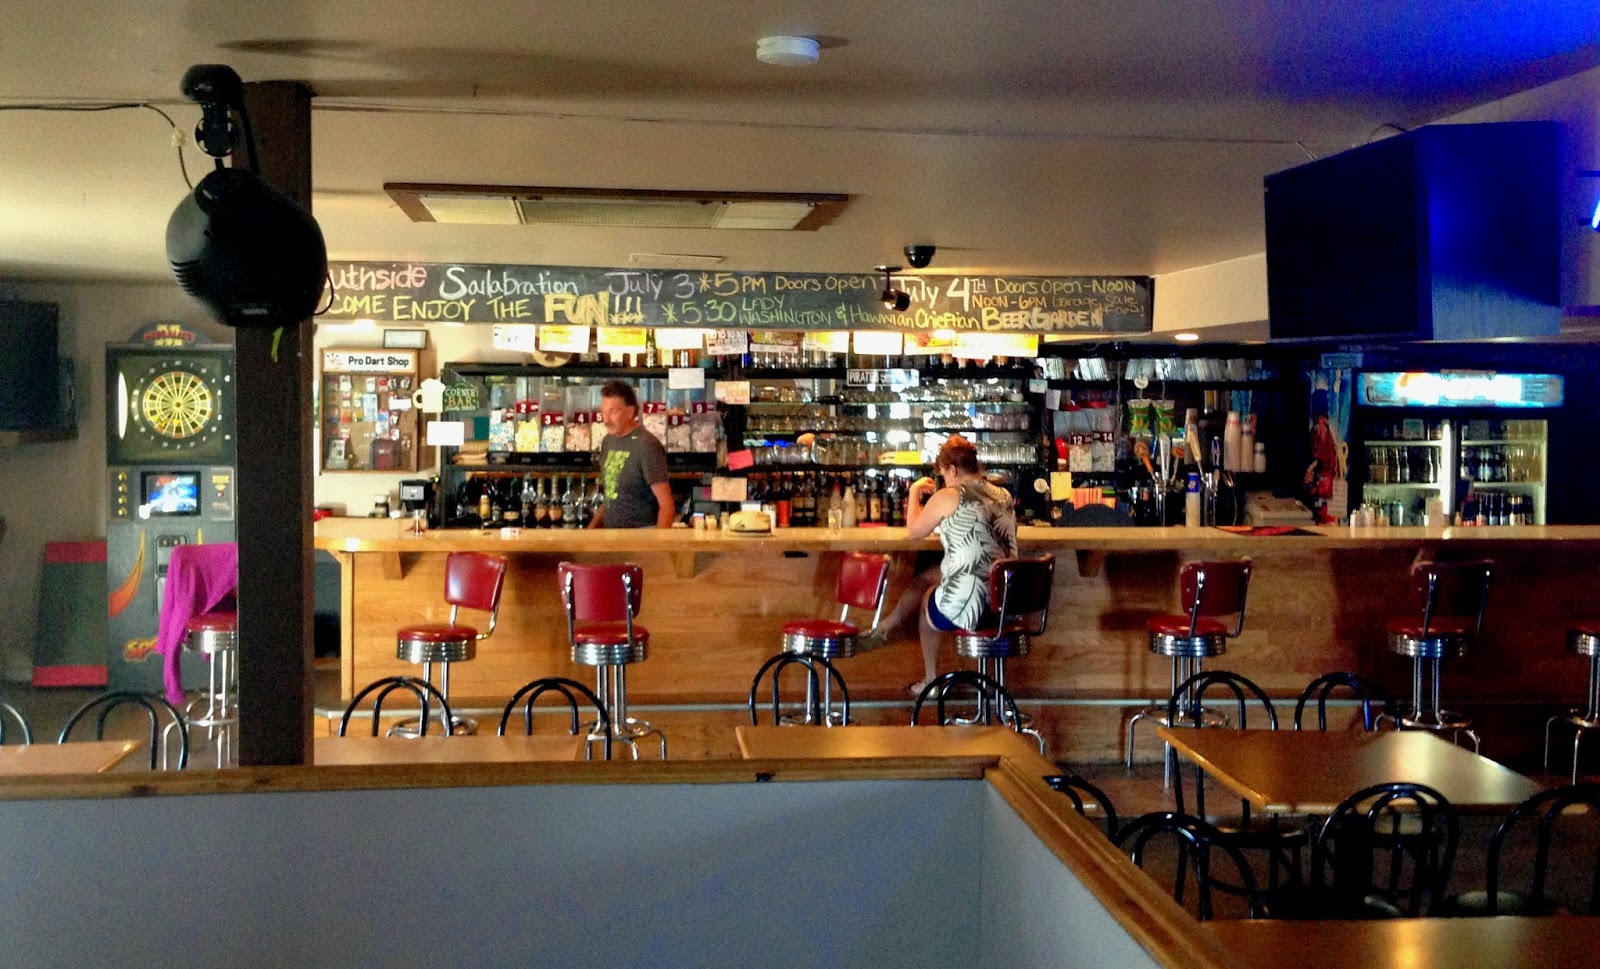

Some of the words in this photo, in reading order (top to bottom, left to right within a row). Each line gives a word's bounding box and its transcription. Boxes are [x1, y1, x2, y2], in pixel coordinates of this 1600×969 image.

[325, 264, 427, 291] uthside
[604, 271, 664, 300] July
[673, 273, 695, 299] 3
[775, 276, 822, 291] Doors
[825, 275, 877, 294] Open
[994, 278, 1038, 294] Doors
[326, 294, 387, 315] COME
[393, 296, 477, 320] ENJOY
[487, 296, 532, 319] THE
[742, 294, 786, 311] LADY
[739, 309, 832, 326] WASHINGTON
[348, 356, 364, 365] Pro
[365, 356, 385, 365] Dart
[387, 356, 409, 368] Shop
[445, 388, 476, 397] CORNER
[448, 395, 473, 407] BAR
[520, 403, 527, 413] 2
[647, 403, 654, 413] 7
[696, 404, 702, 413] 9
[545, 414, 551, 425] 3
[578, 414, 584, 423] 4
[596, 413, 602, 421] 5
[1072, 436, 1083, 445] 12
[1103, 432, 1113, 442] 14
